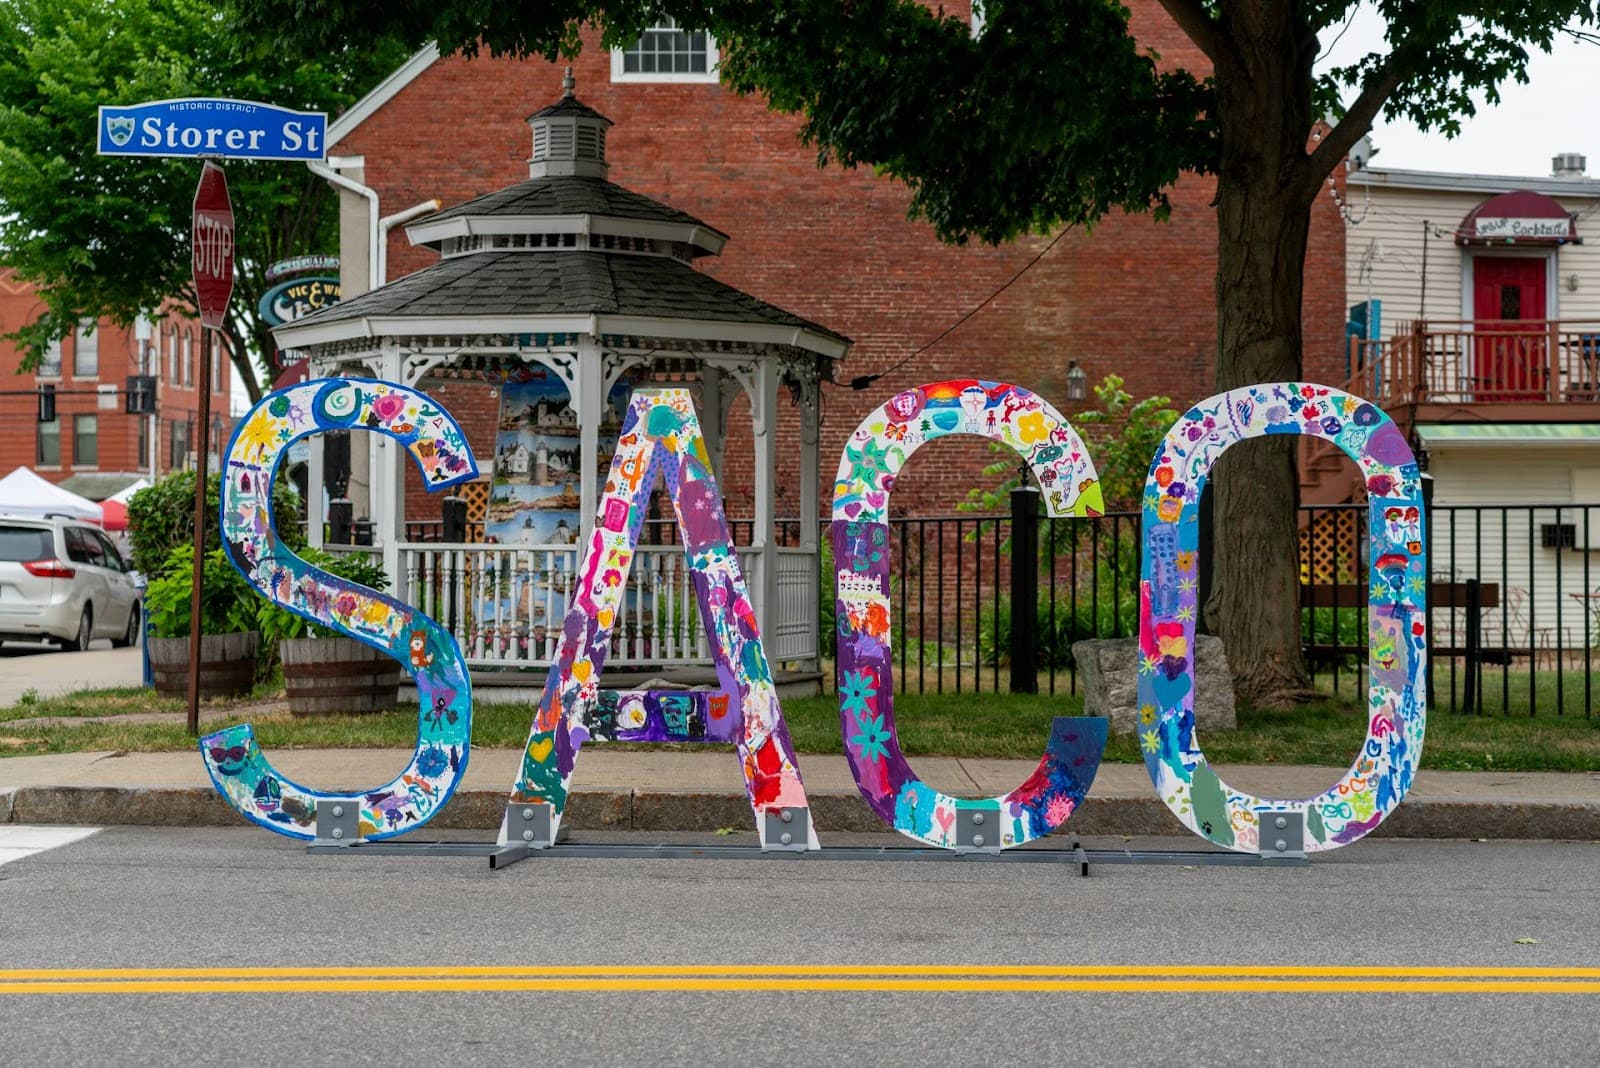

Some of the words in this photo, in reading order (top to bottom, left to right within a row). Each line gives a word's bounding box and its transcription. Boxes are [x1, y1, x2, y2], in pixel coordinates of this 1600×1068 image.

[169, 102, 212, 112] HISTORIC
[215, 102, 257, 114] DISTRICT
[140, 116, 266, 150] Storer
[281, 121, 320, 152] St
[196, 213, 232, 281] STOP
[288, 285, 308, 299] VIC
[308, 281, 325, 309] &
[200, 376, 1428, 854] SACO
